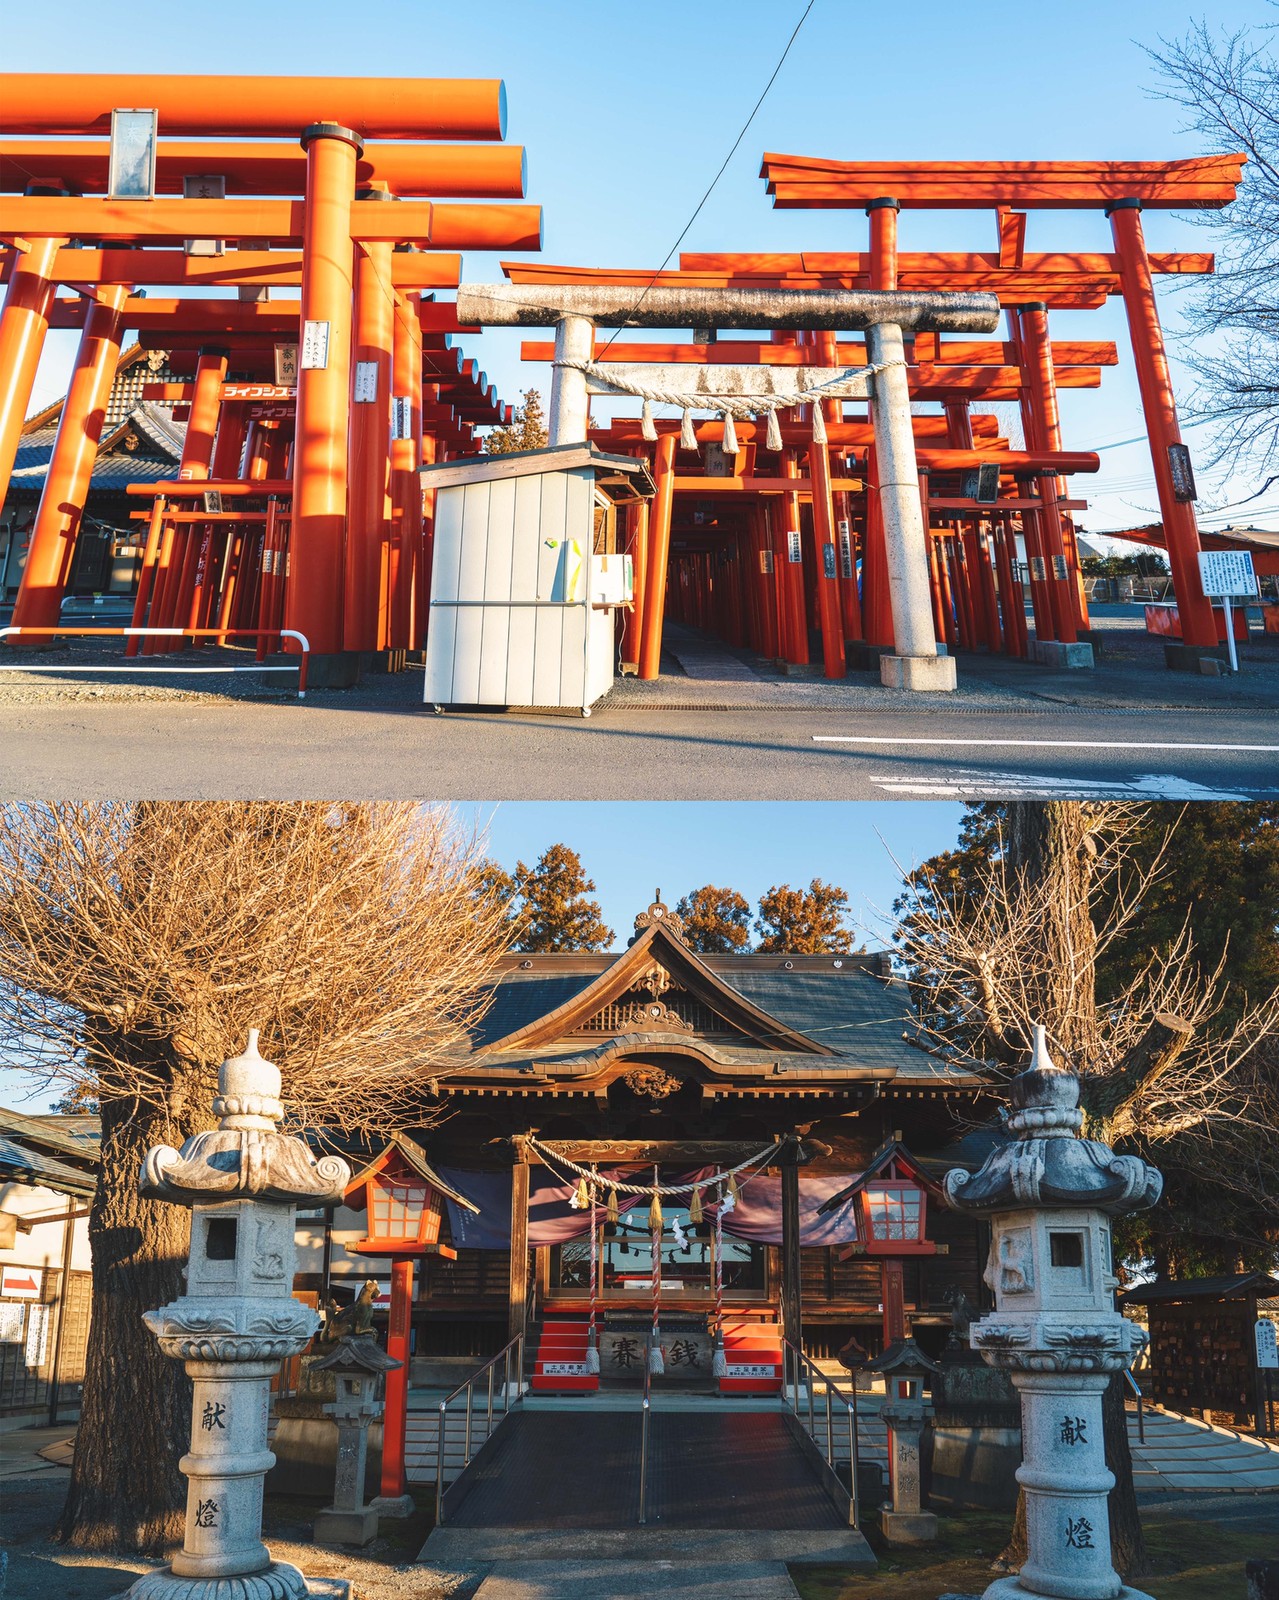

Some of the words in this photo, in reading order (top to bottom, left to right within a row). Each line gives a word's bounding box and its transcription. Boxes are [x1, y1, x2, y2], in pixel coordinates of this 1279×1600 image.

[282, 348, 295, 374] 奉納
[840, 522, 851, 578] 第一工業株式会社
[612, 1337, 700, 1369] 賽銭
[195, 1401, 226, 1528] 献燈
[1060, 1415, 1095, 1550] 献燈
